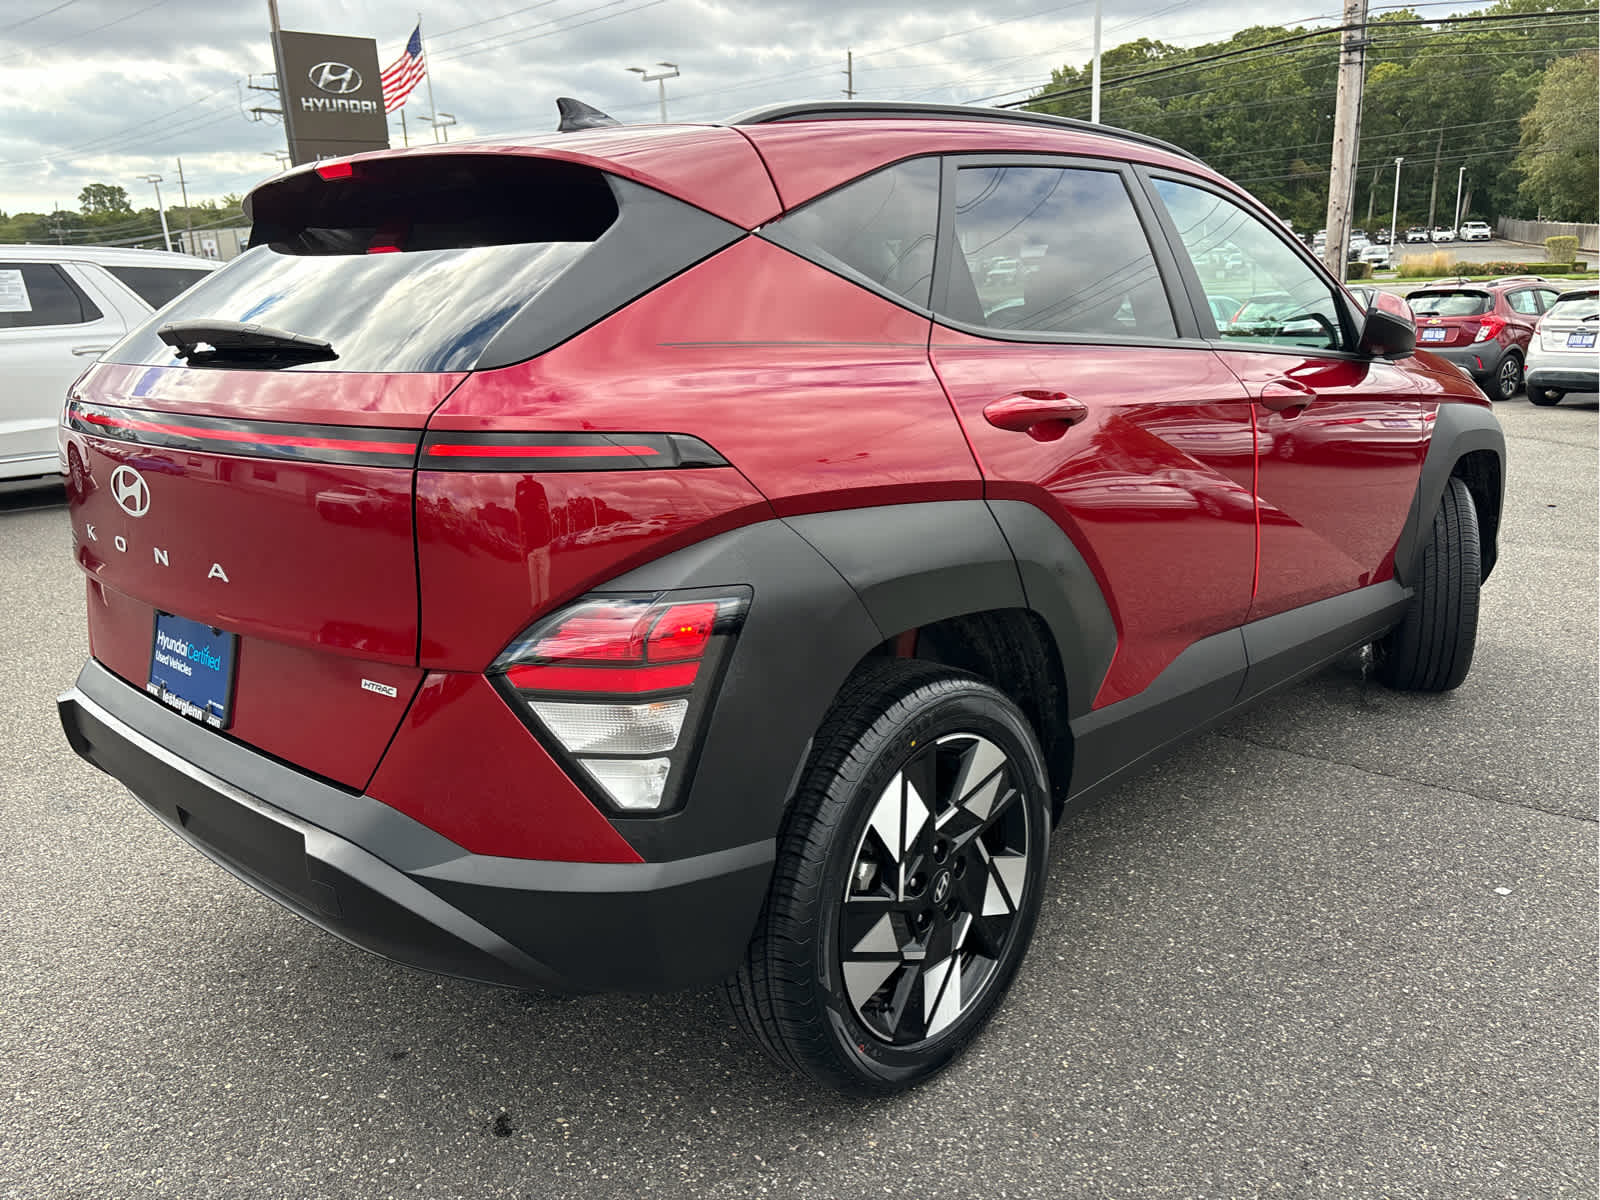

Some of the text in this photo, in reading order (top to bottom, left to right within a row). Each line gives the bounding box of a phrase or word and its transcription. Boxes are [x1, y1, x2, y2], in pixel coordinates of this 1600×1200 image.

[301, 97, 377, 113] HYUNDAI
[86, 523, 229, 583] KONA
[155, 650, 192, 676] Used Vehicles
[157, 630, 221, 671] Hyundai Certified
[363, 680, 394, 696] HTRAC
[163, 689, 203, 721] lesterglenn
